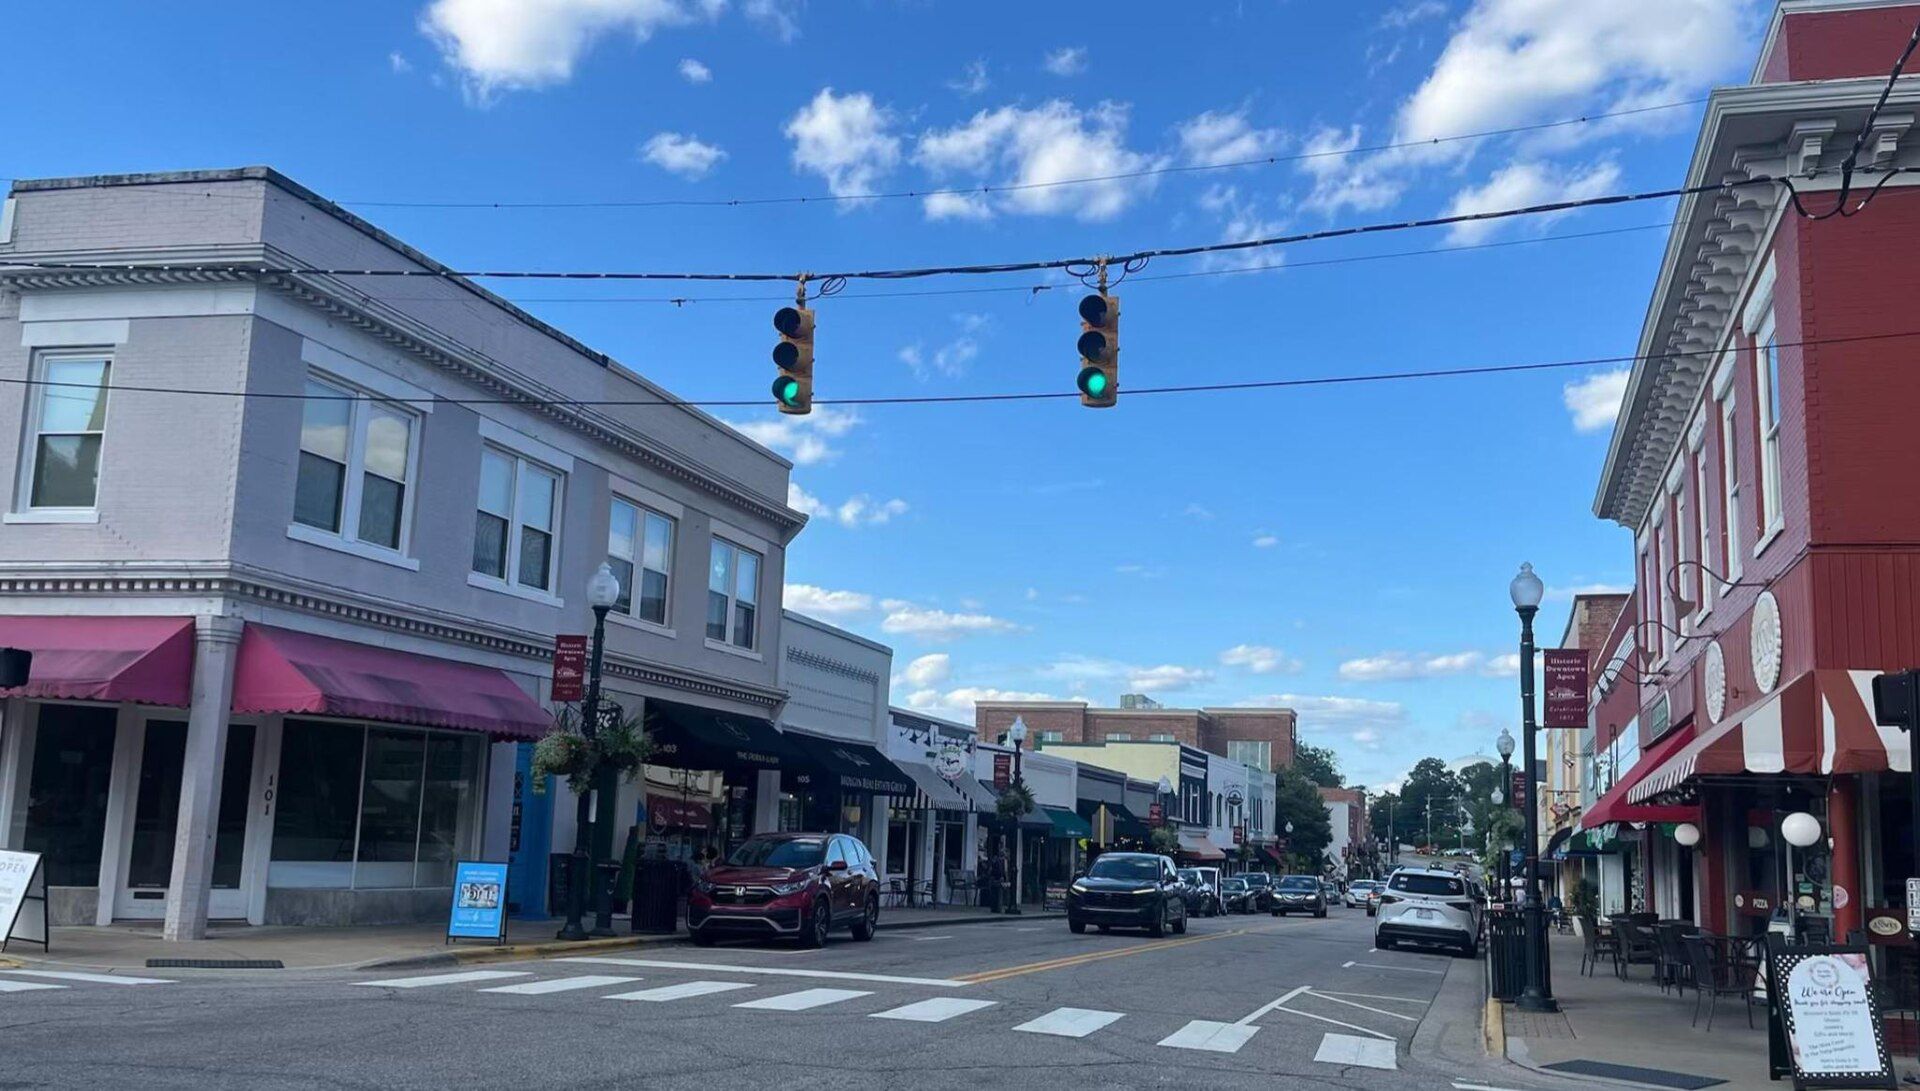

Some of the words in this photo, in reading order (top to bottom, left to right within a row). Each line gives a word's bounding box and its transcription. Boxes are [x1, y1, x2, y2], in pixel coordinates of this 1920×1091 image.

[1556, 673, 1576, 681] Apex
[1753, 898, 1769, 909] PIZZA
[1834, 986, 1856, 1000] Open
